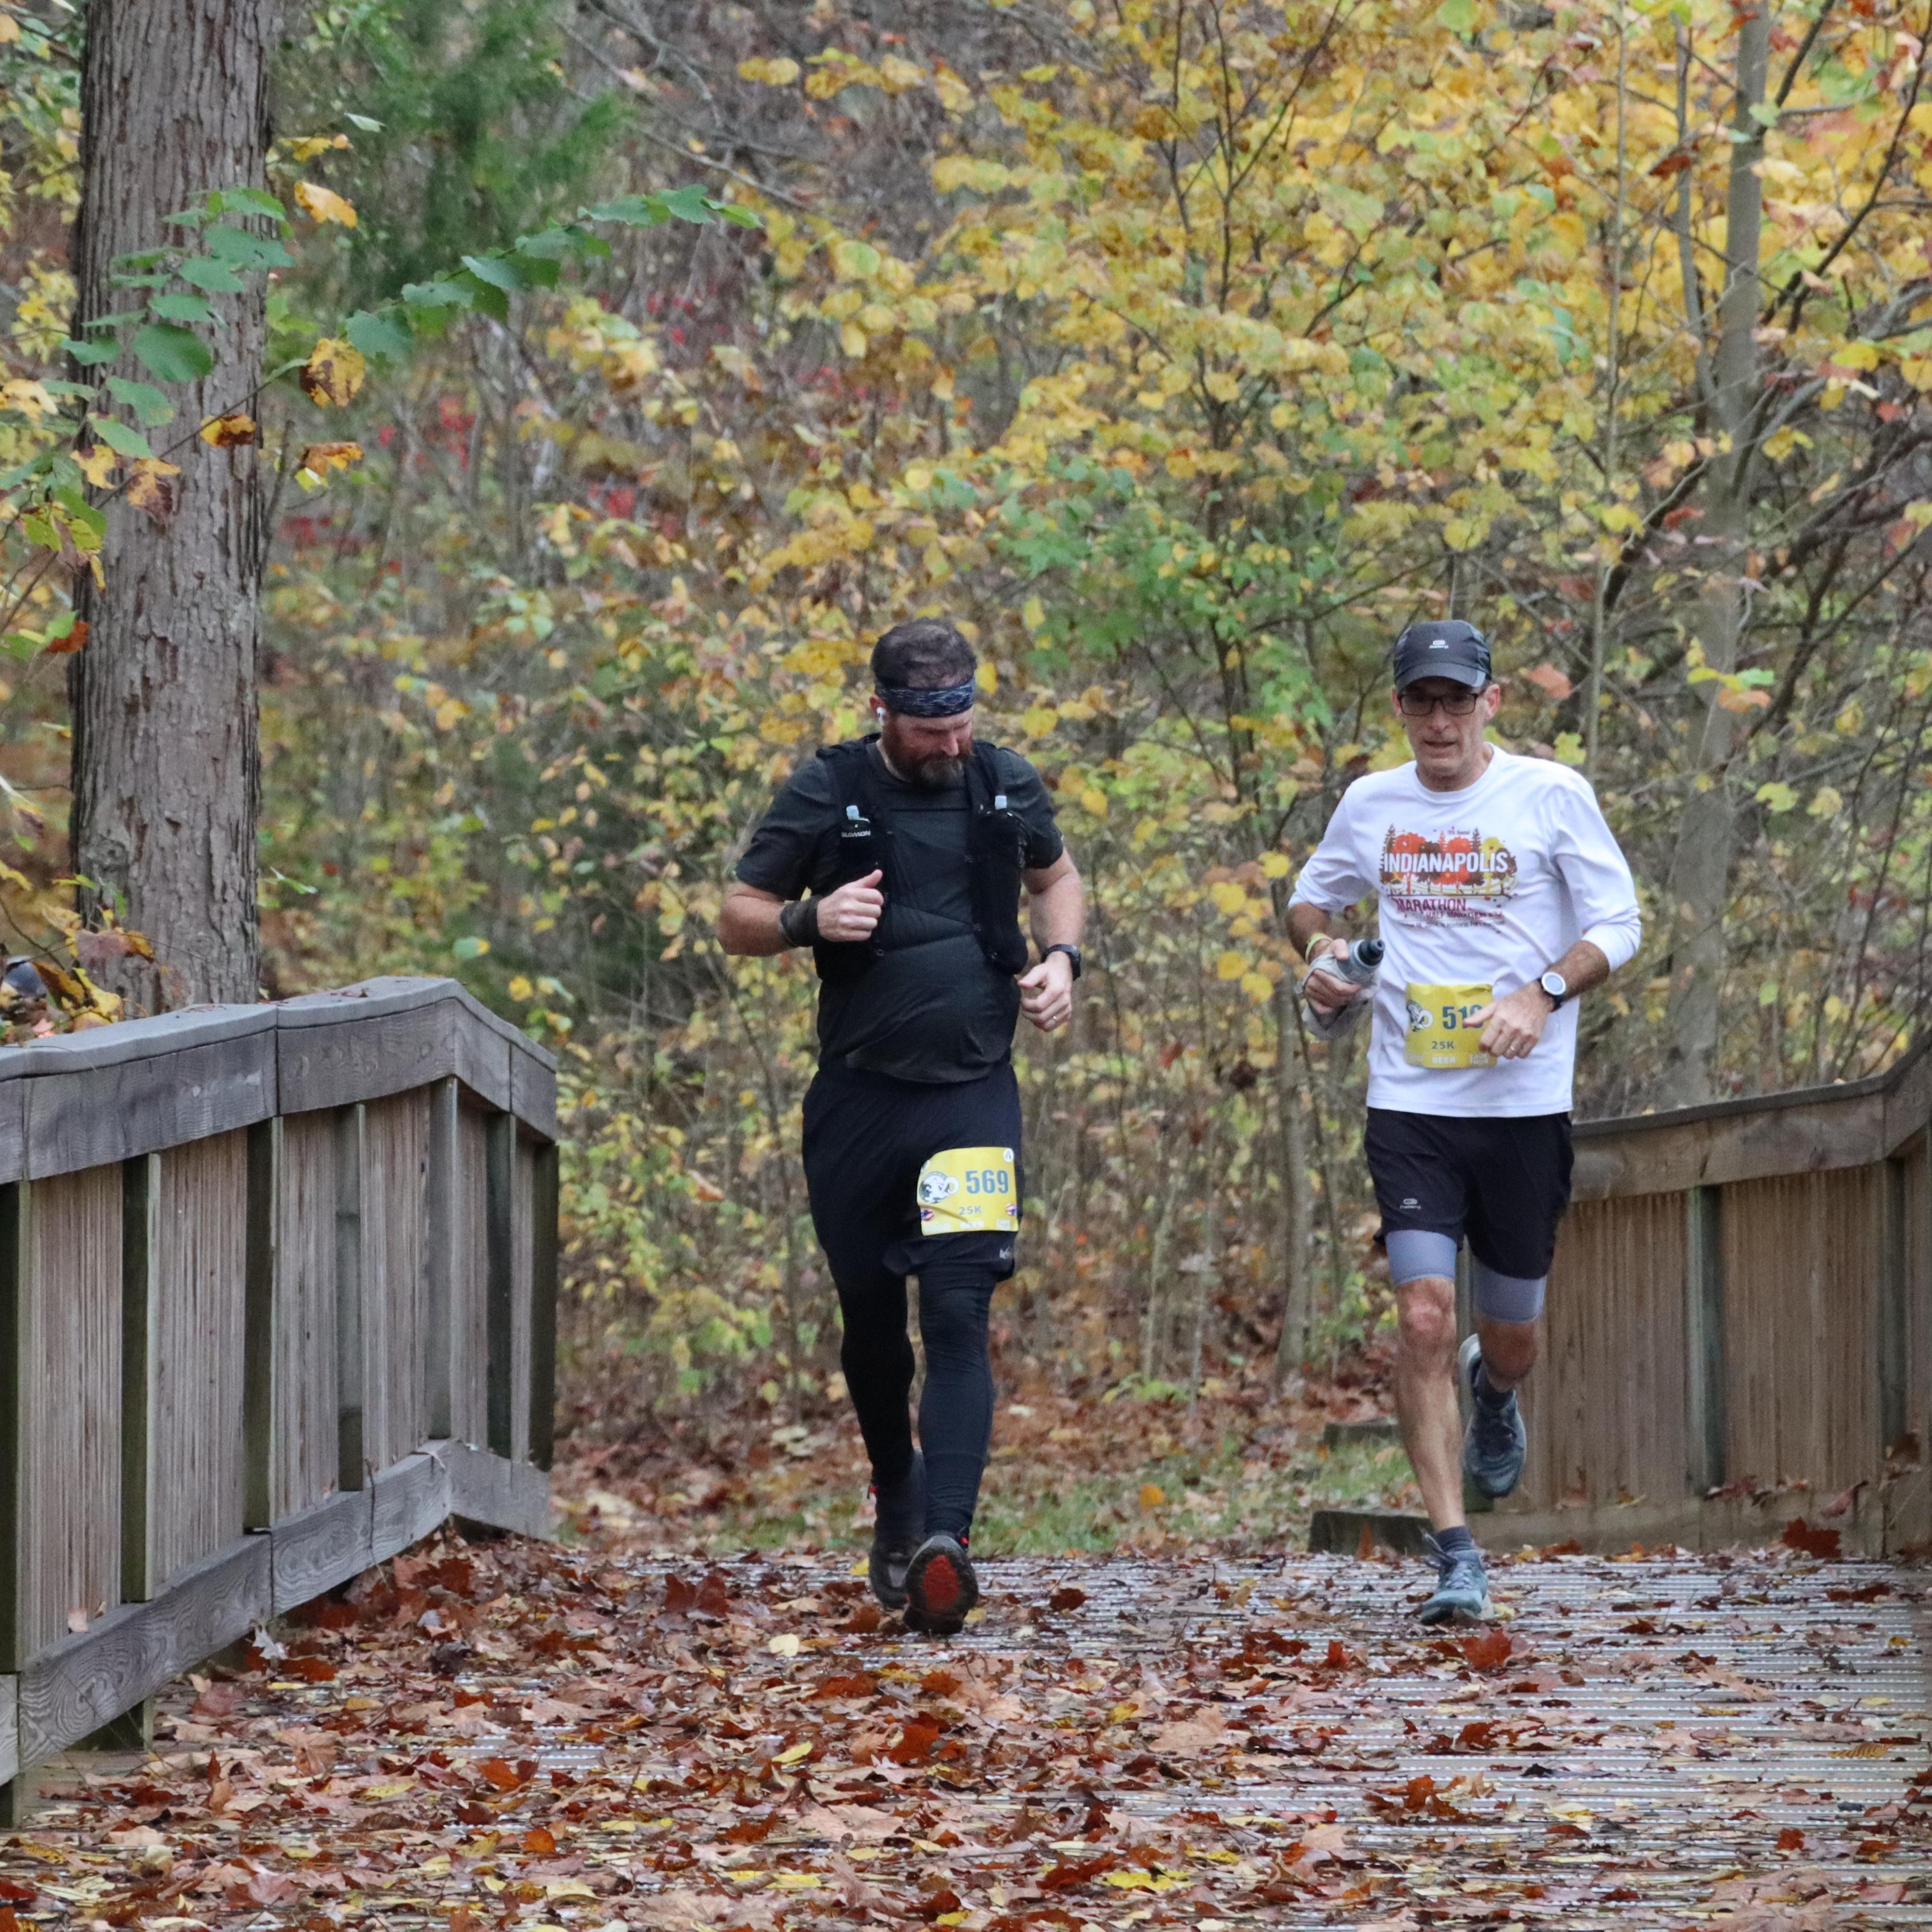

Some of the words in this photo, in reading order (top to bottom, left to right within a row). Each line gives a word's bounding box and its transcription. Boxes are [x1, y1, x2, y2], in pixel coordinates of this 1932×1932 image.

[1383, 851, 1508, 873] INDIANAPOLIS
[1395, 898, 1467, 912] MARATHON
[1432, 1041, 1455, 1050] 25K
[965, 1170, 1009, 1194] 569
[959, 1205, 983, 1216] 25K
